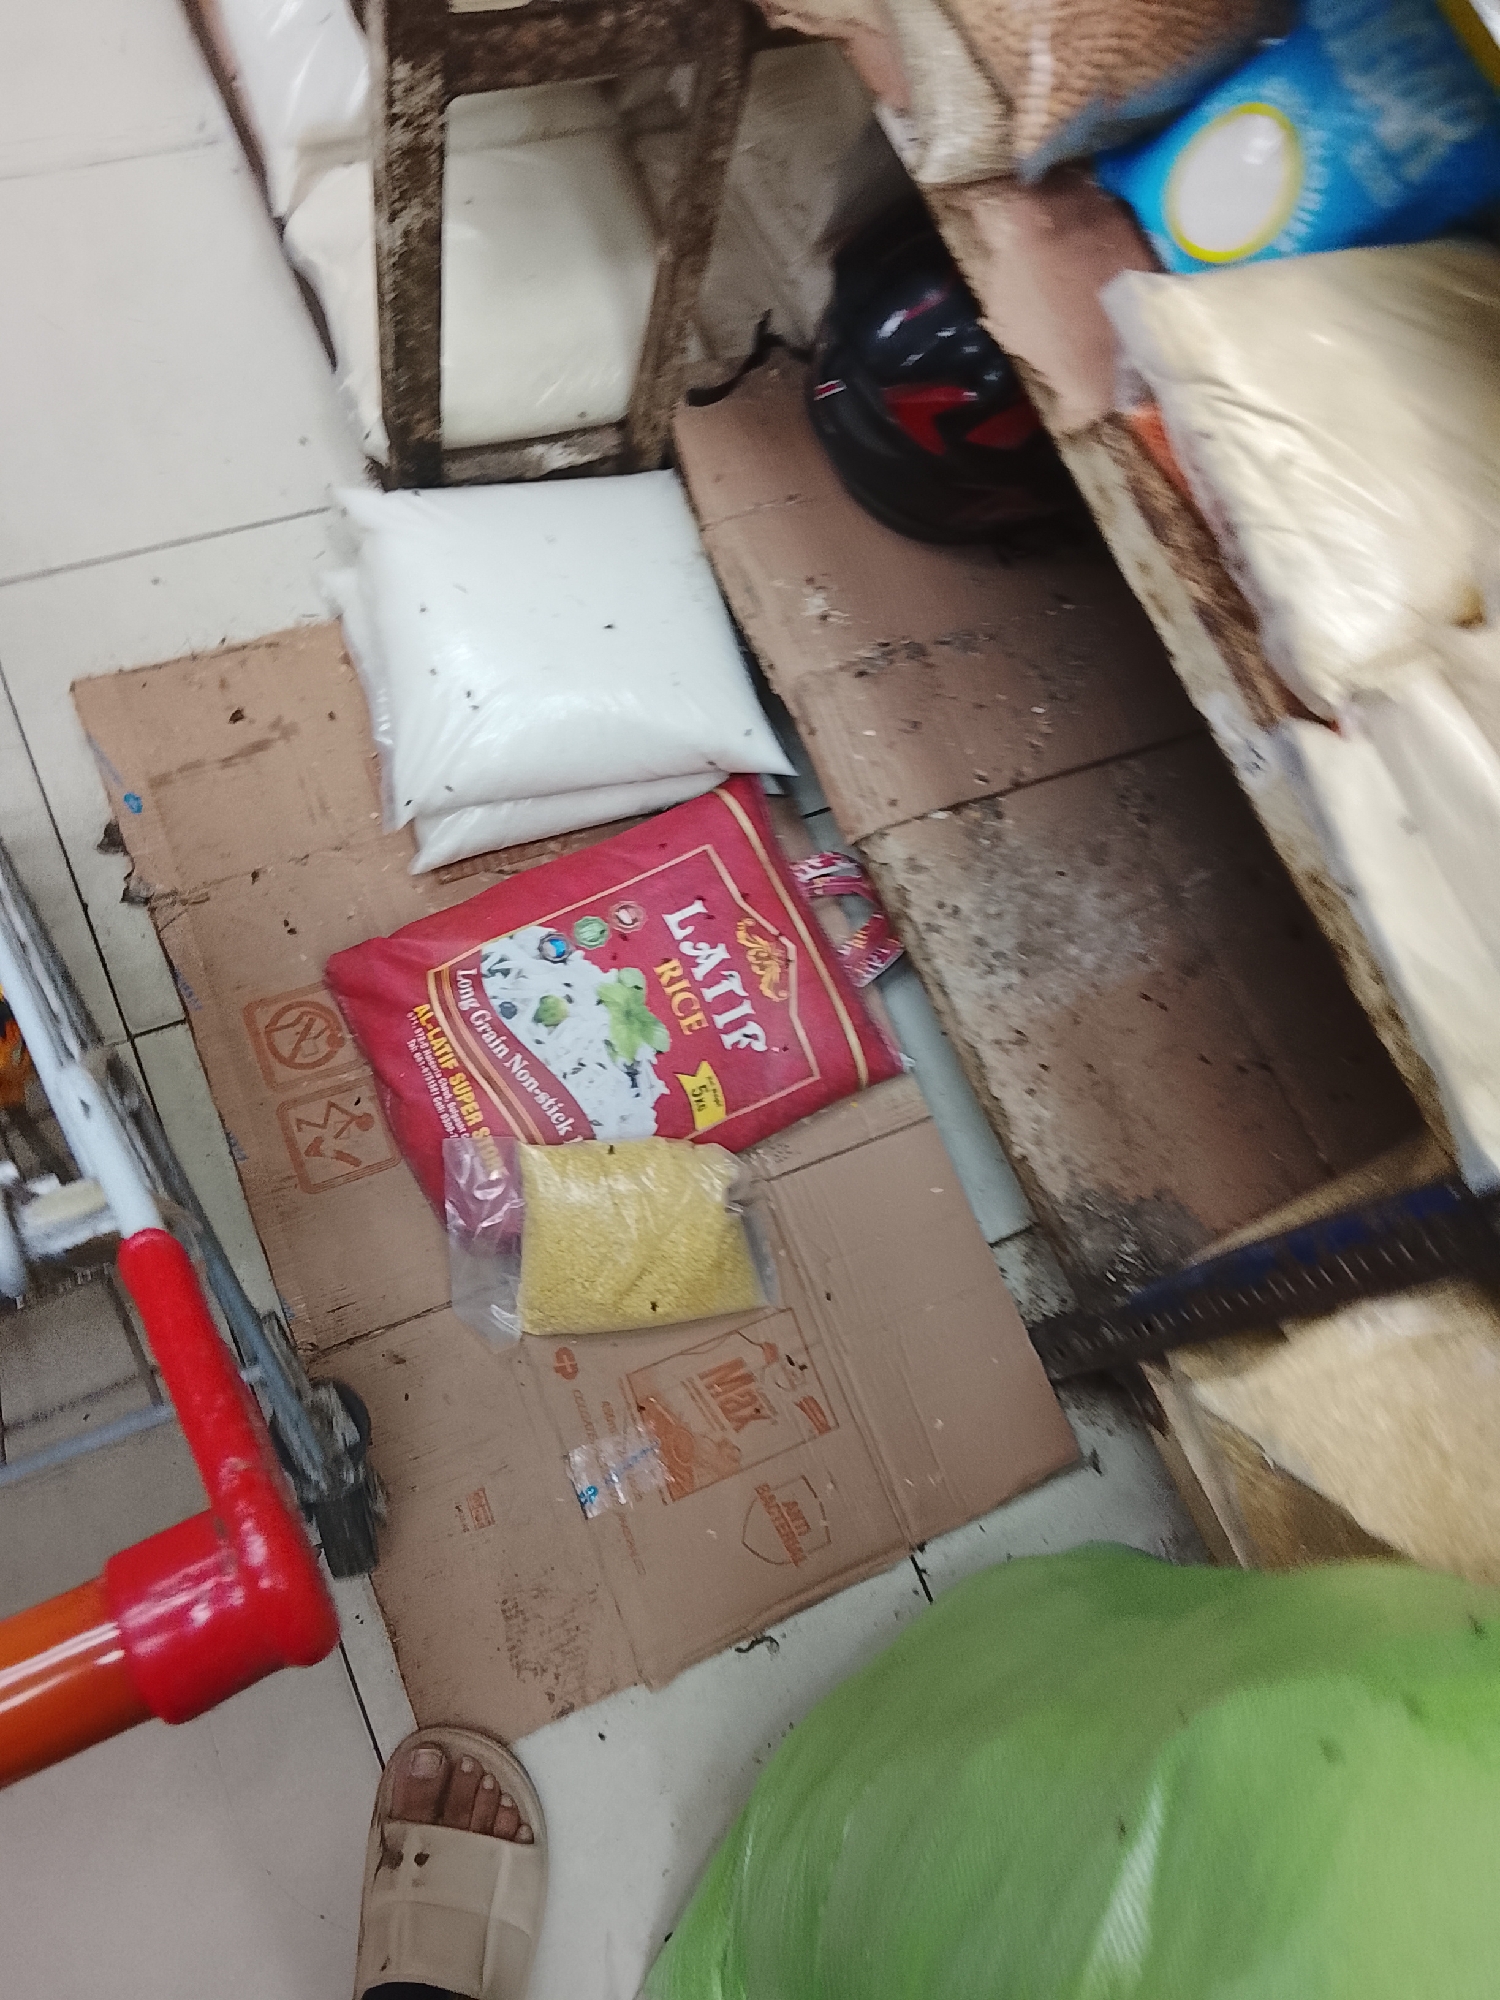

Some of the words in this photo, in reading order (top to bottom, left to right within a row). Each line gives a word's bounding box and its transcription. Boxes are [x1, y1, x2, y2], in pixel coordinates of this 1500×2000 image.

[651, 956, 710, 1037] RICE
[661, 900, 767, 1051] LATIF
[413, 1003, 459, 1070] AL-LATIF
[447, 1073, 484, 1126] SUPER
[456, 966, 480, 1010] Long
[470, 1008, 508, 1060] Grain
[503, 1051, 575, 1137] Non-stick
[697, 1356, 770, 1433] Max
